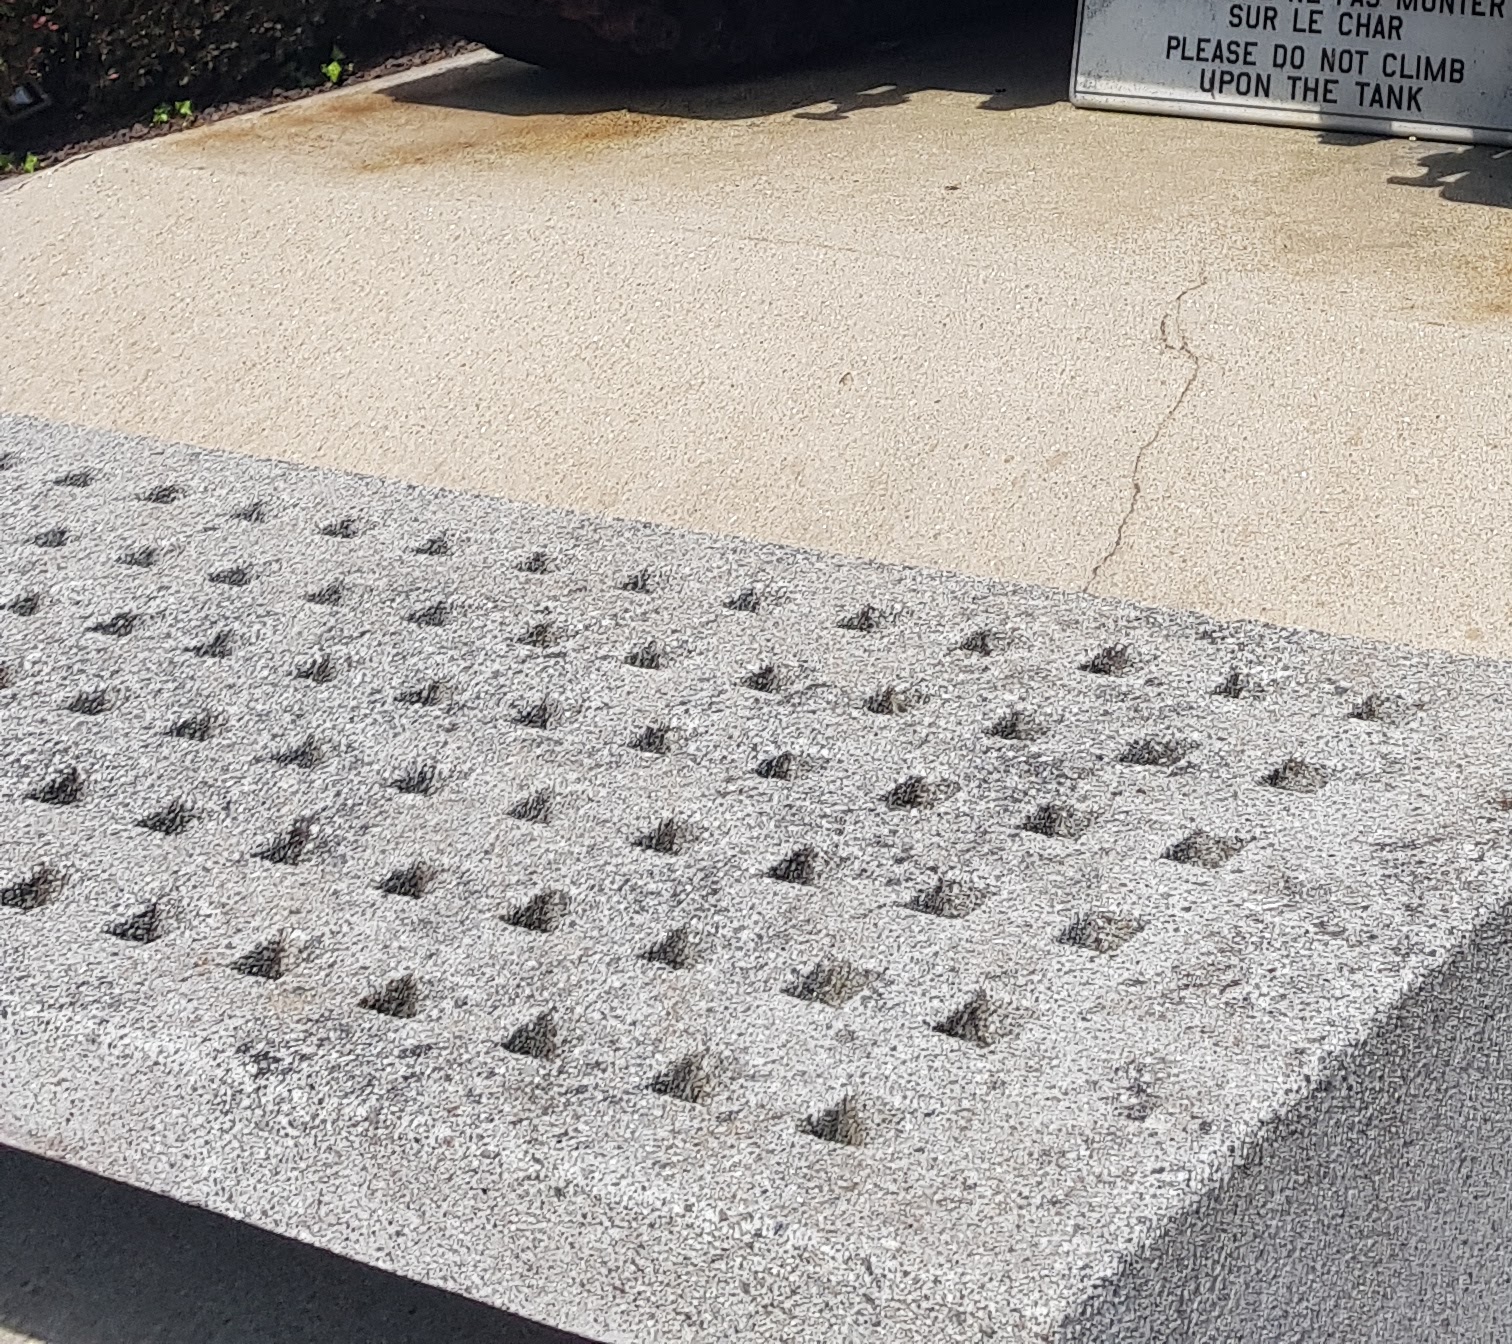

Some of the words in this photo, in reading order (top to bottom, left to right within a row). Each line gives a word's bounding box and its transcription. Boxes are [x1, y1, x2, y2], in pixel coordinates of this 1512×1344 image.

[1228, 3, 1278, 31] SUR
[1292, 7, 1324, 34] LE
[1338, 11, 1404, 41] CHAR
[1165, 35, 1258, 66] PLEASE
[1272, 43, 1305, 70] DO
[1320, 47, 1369, 75] NOT
[1382, 52, 1465, 84] CLIMB
[1200, 68, 1272, 99] UPON
[1287, 75, 1340, 104] THE
[1354, 81, 1424, 113] TANK
